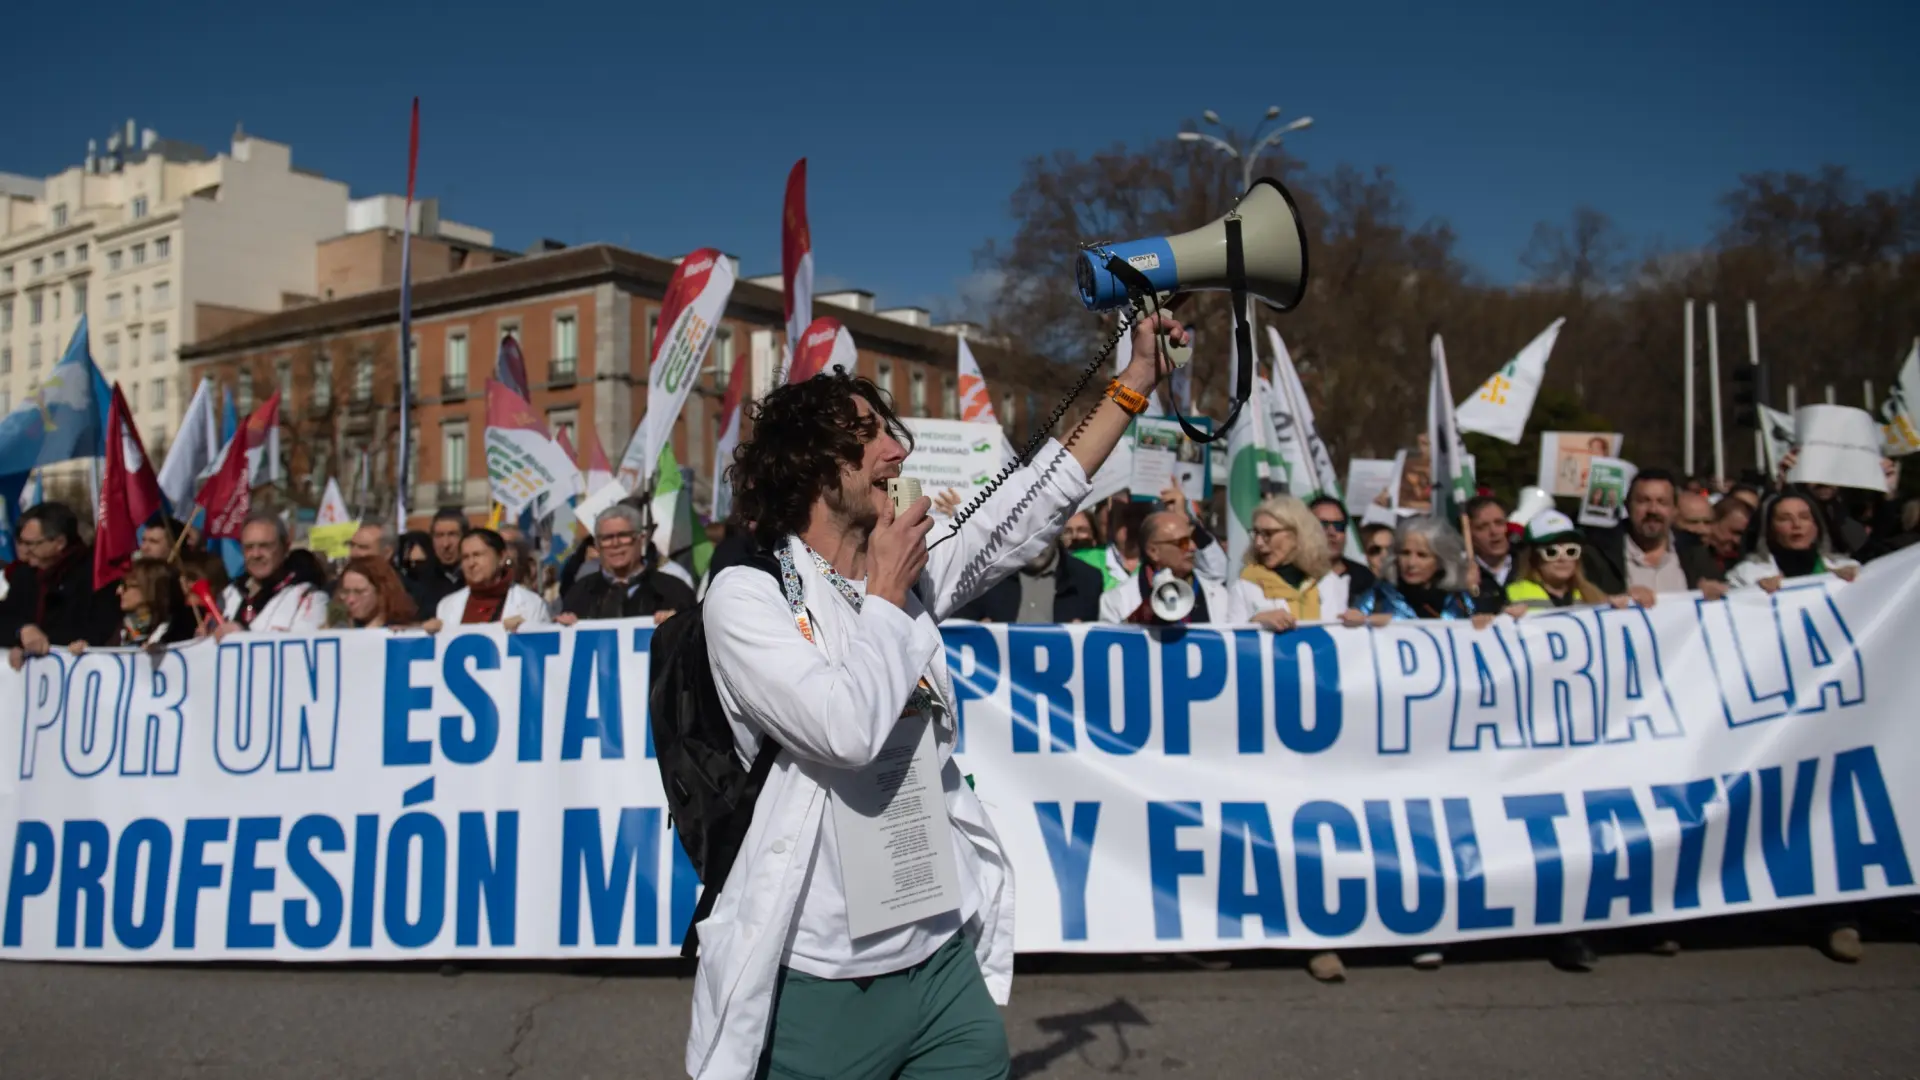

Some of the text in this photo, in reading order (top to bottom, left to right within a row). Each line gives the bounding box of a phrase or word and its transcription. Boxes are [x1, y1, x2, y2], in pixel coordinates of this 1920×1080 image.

[1130, 254, 1156, 263] VONYX
[930, 446, 970, 456] SANIDAD
[20, 648, 188, 780] POR
[214, 638, 341, 775] UN
[938, 623, 1344, 755] PROPIO
[1368, 605, 1685, 755] PARA
[1695, 583, 1866, 729] LA
[3, 776, 519, 950] PROFESIÓN
[1033, 801, 1101, 942] Y
[1147, 745, 1916, 941] FACULTATIVA
